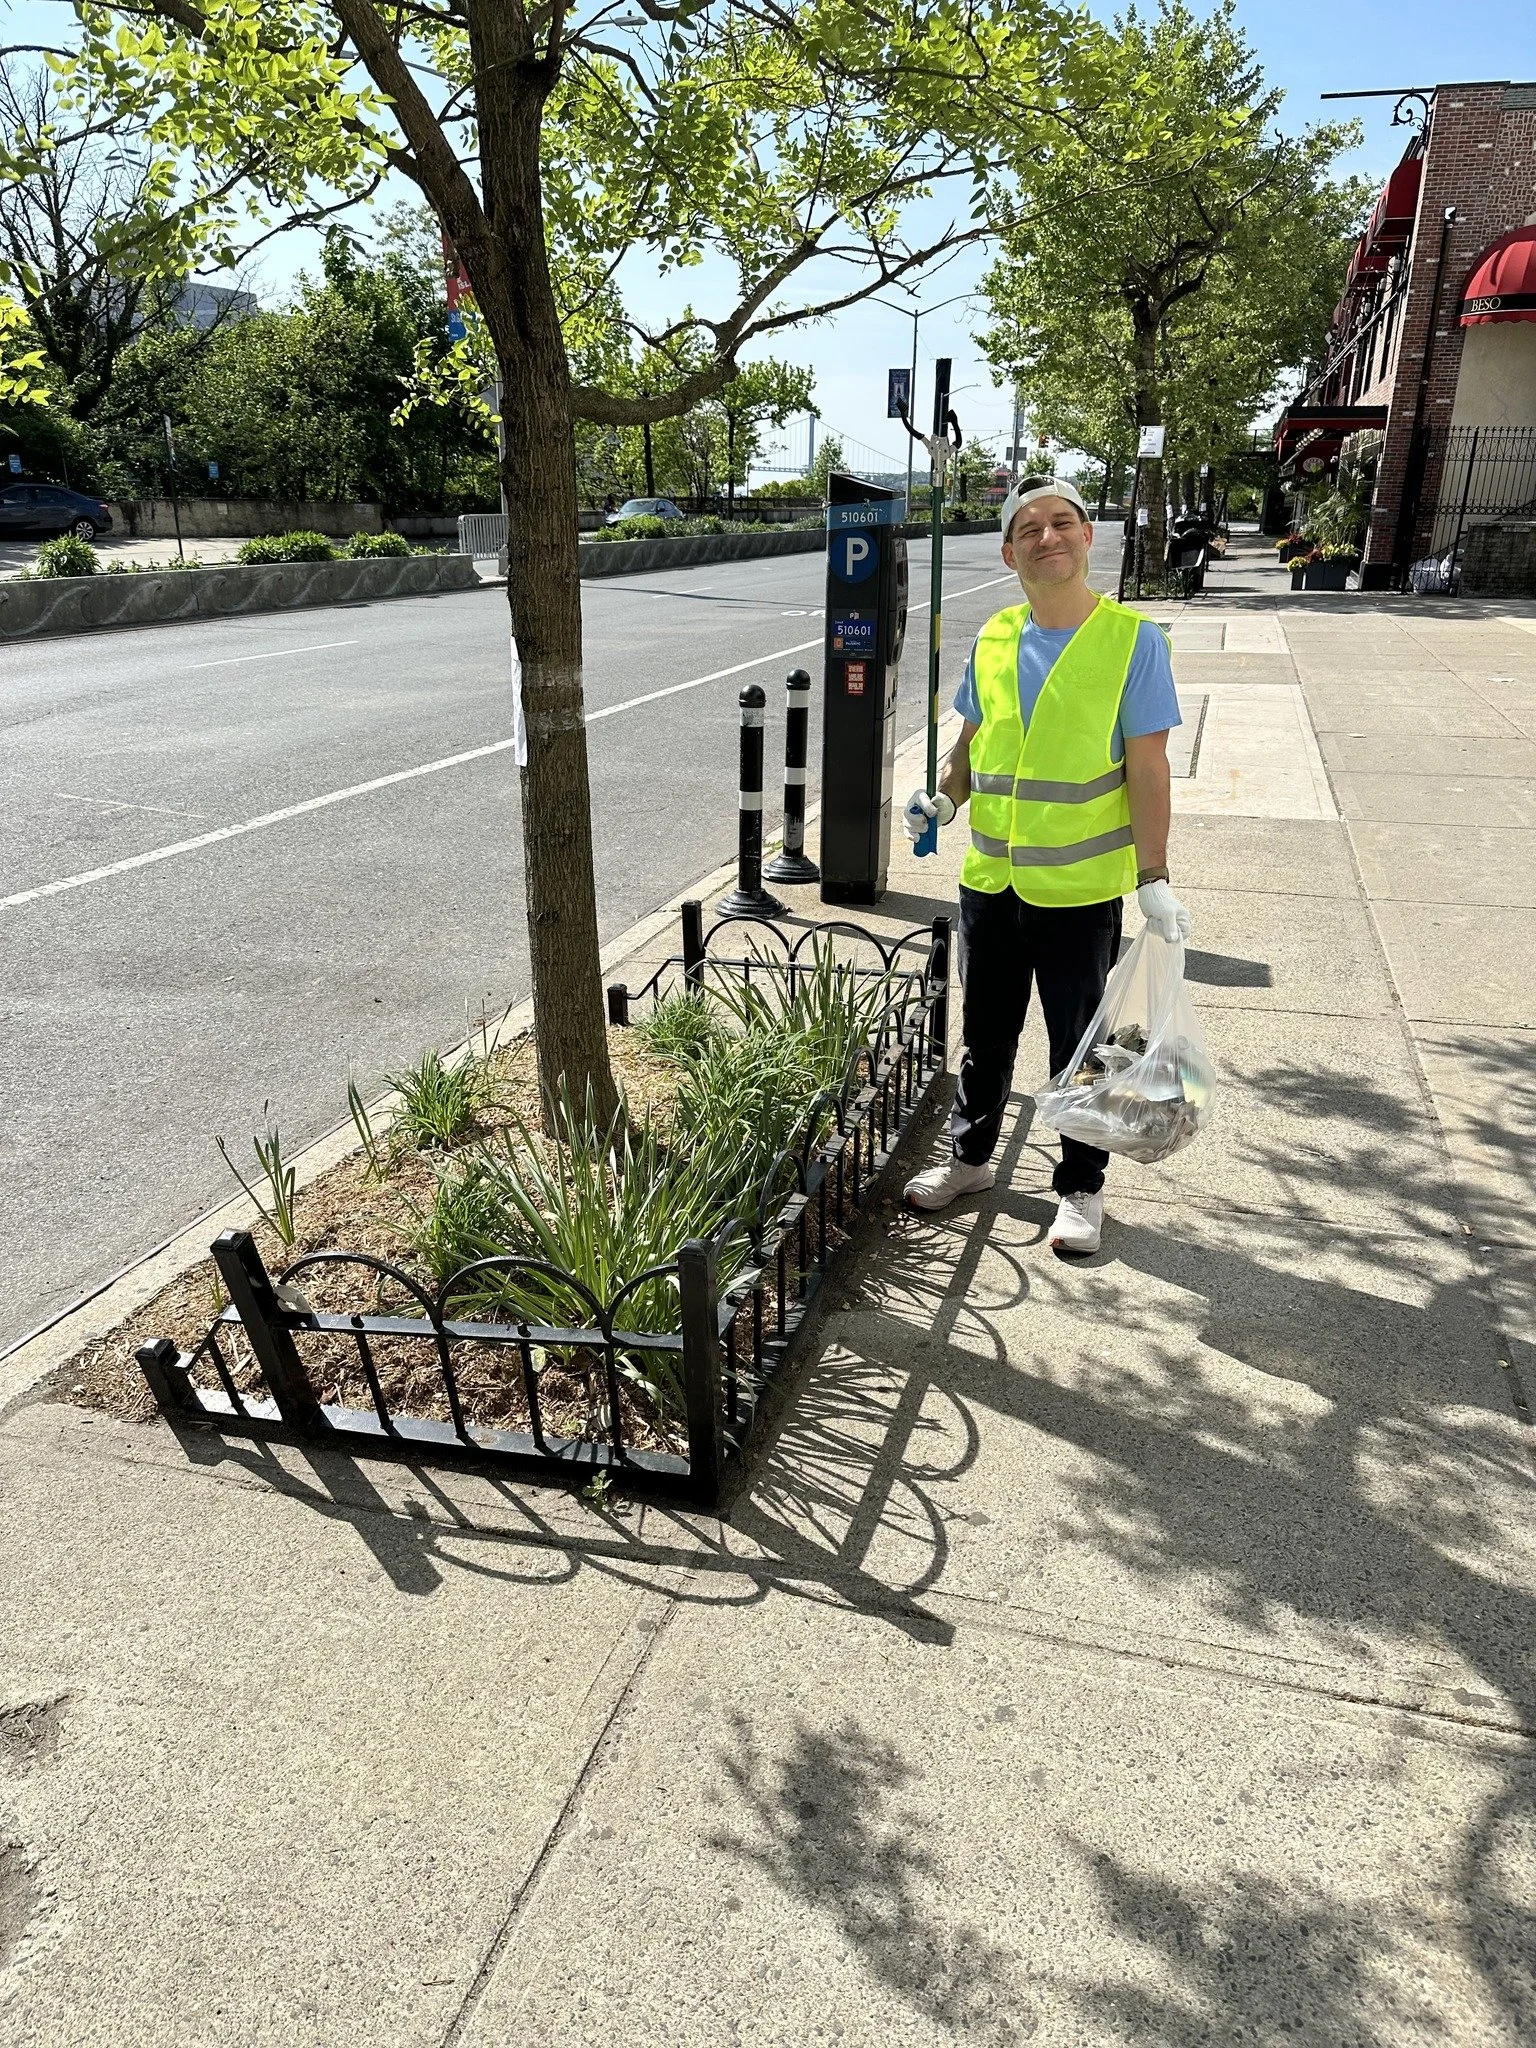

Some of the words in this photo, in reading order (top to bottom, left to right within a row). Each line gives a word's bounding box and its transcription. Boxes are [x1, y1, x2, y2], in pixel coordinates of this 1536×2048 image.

[1471, 296, 1501, 312] BESO
[841, 511, 878, 523] 510601
[846, 537, 869, 576] P
[837, 625, 870, 636] 510601
